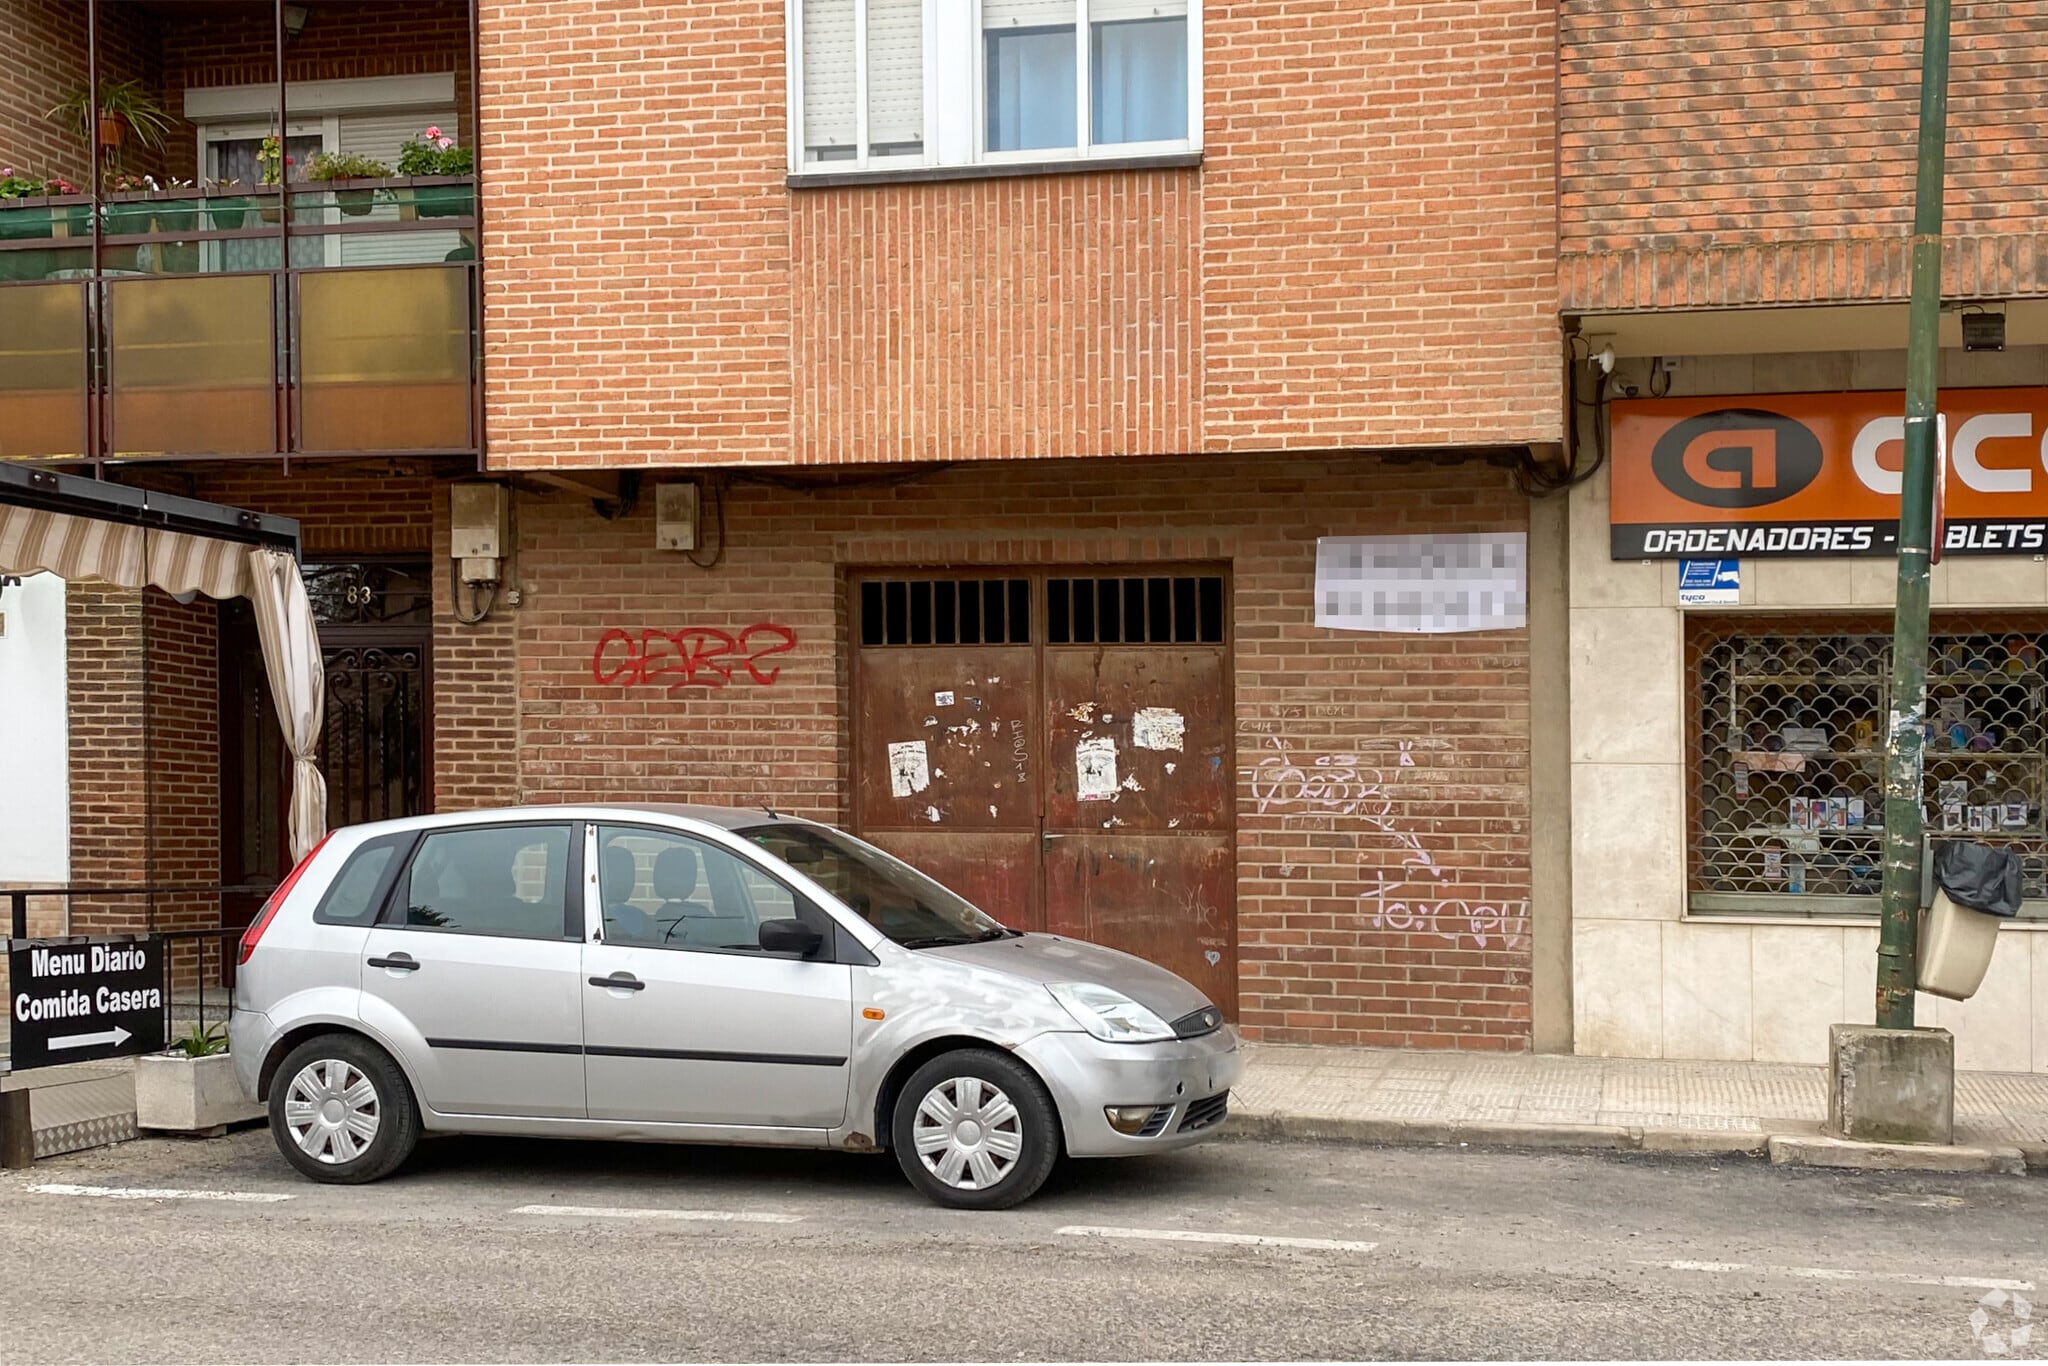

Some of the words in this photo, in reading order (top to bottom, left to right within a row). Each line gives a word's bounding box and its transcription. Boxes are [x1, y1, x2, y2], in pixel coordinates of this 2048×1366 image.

[1643, 526, 1875, 553] ORDENADORES
[1942, 524, 2046, 549] BLETS
[347, 585, 371, 604] 83
[1680, 594, 1706, 603] tyco
[31, 949, 85, 977] Menu
[91, 944, 146, 973] Diario
[15, 989, 91, 1022] Comida
[96, 986, 161, 1014] Casera
